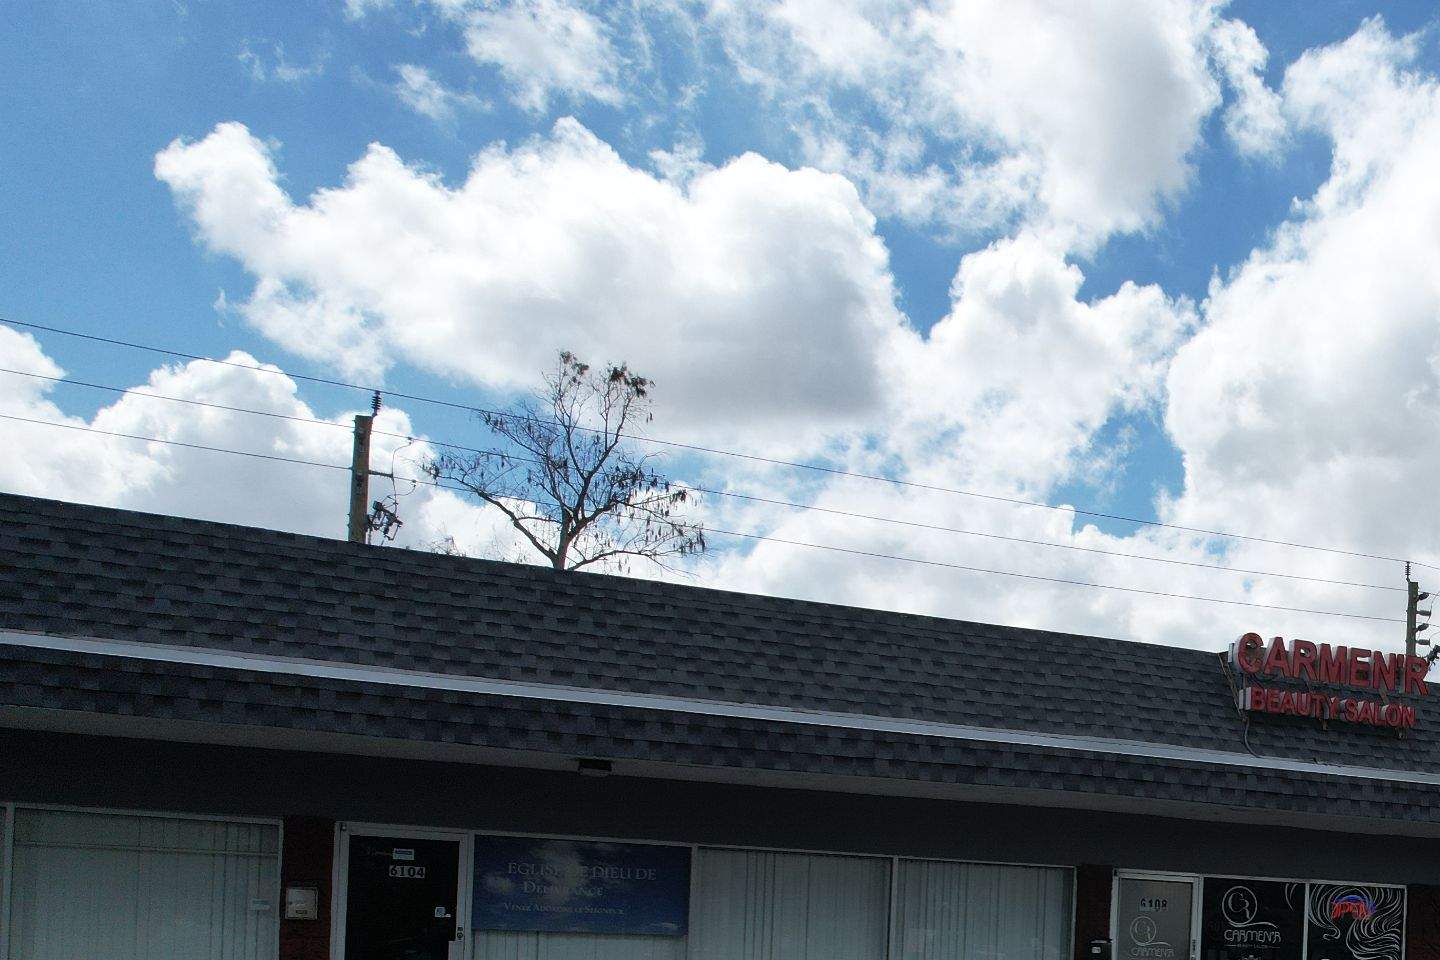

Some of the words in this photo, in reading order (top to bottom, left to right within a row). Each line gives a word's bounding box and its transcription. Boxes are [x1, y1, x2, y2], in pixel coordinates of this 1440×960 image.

[1237, 632, 1430, 696] CARMEN'R
[1249, 686, 1339, 720] BEAUTY
[1342, 698, 1416, 728] SALON
[391, 865, 425, 878] 6104
[635, 867, 657, 881] DE
